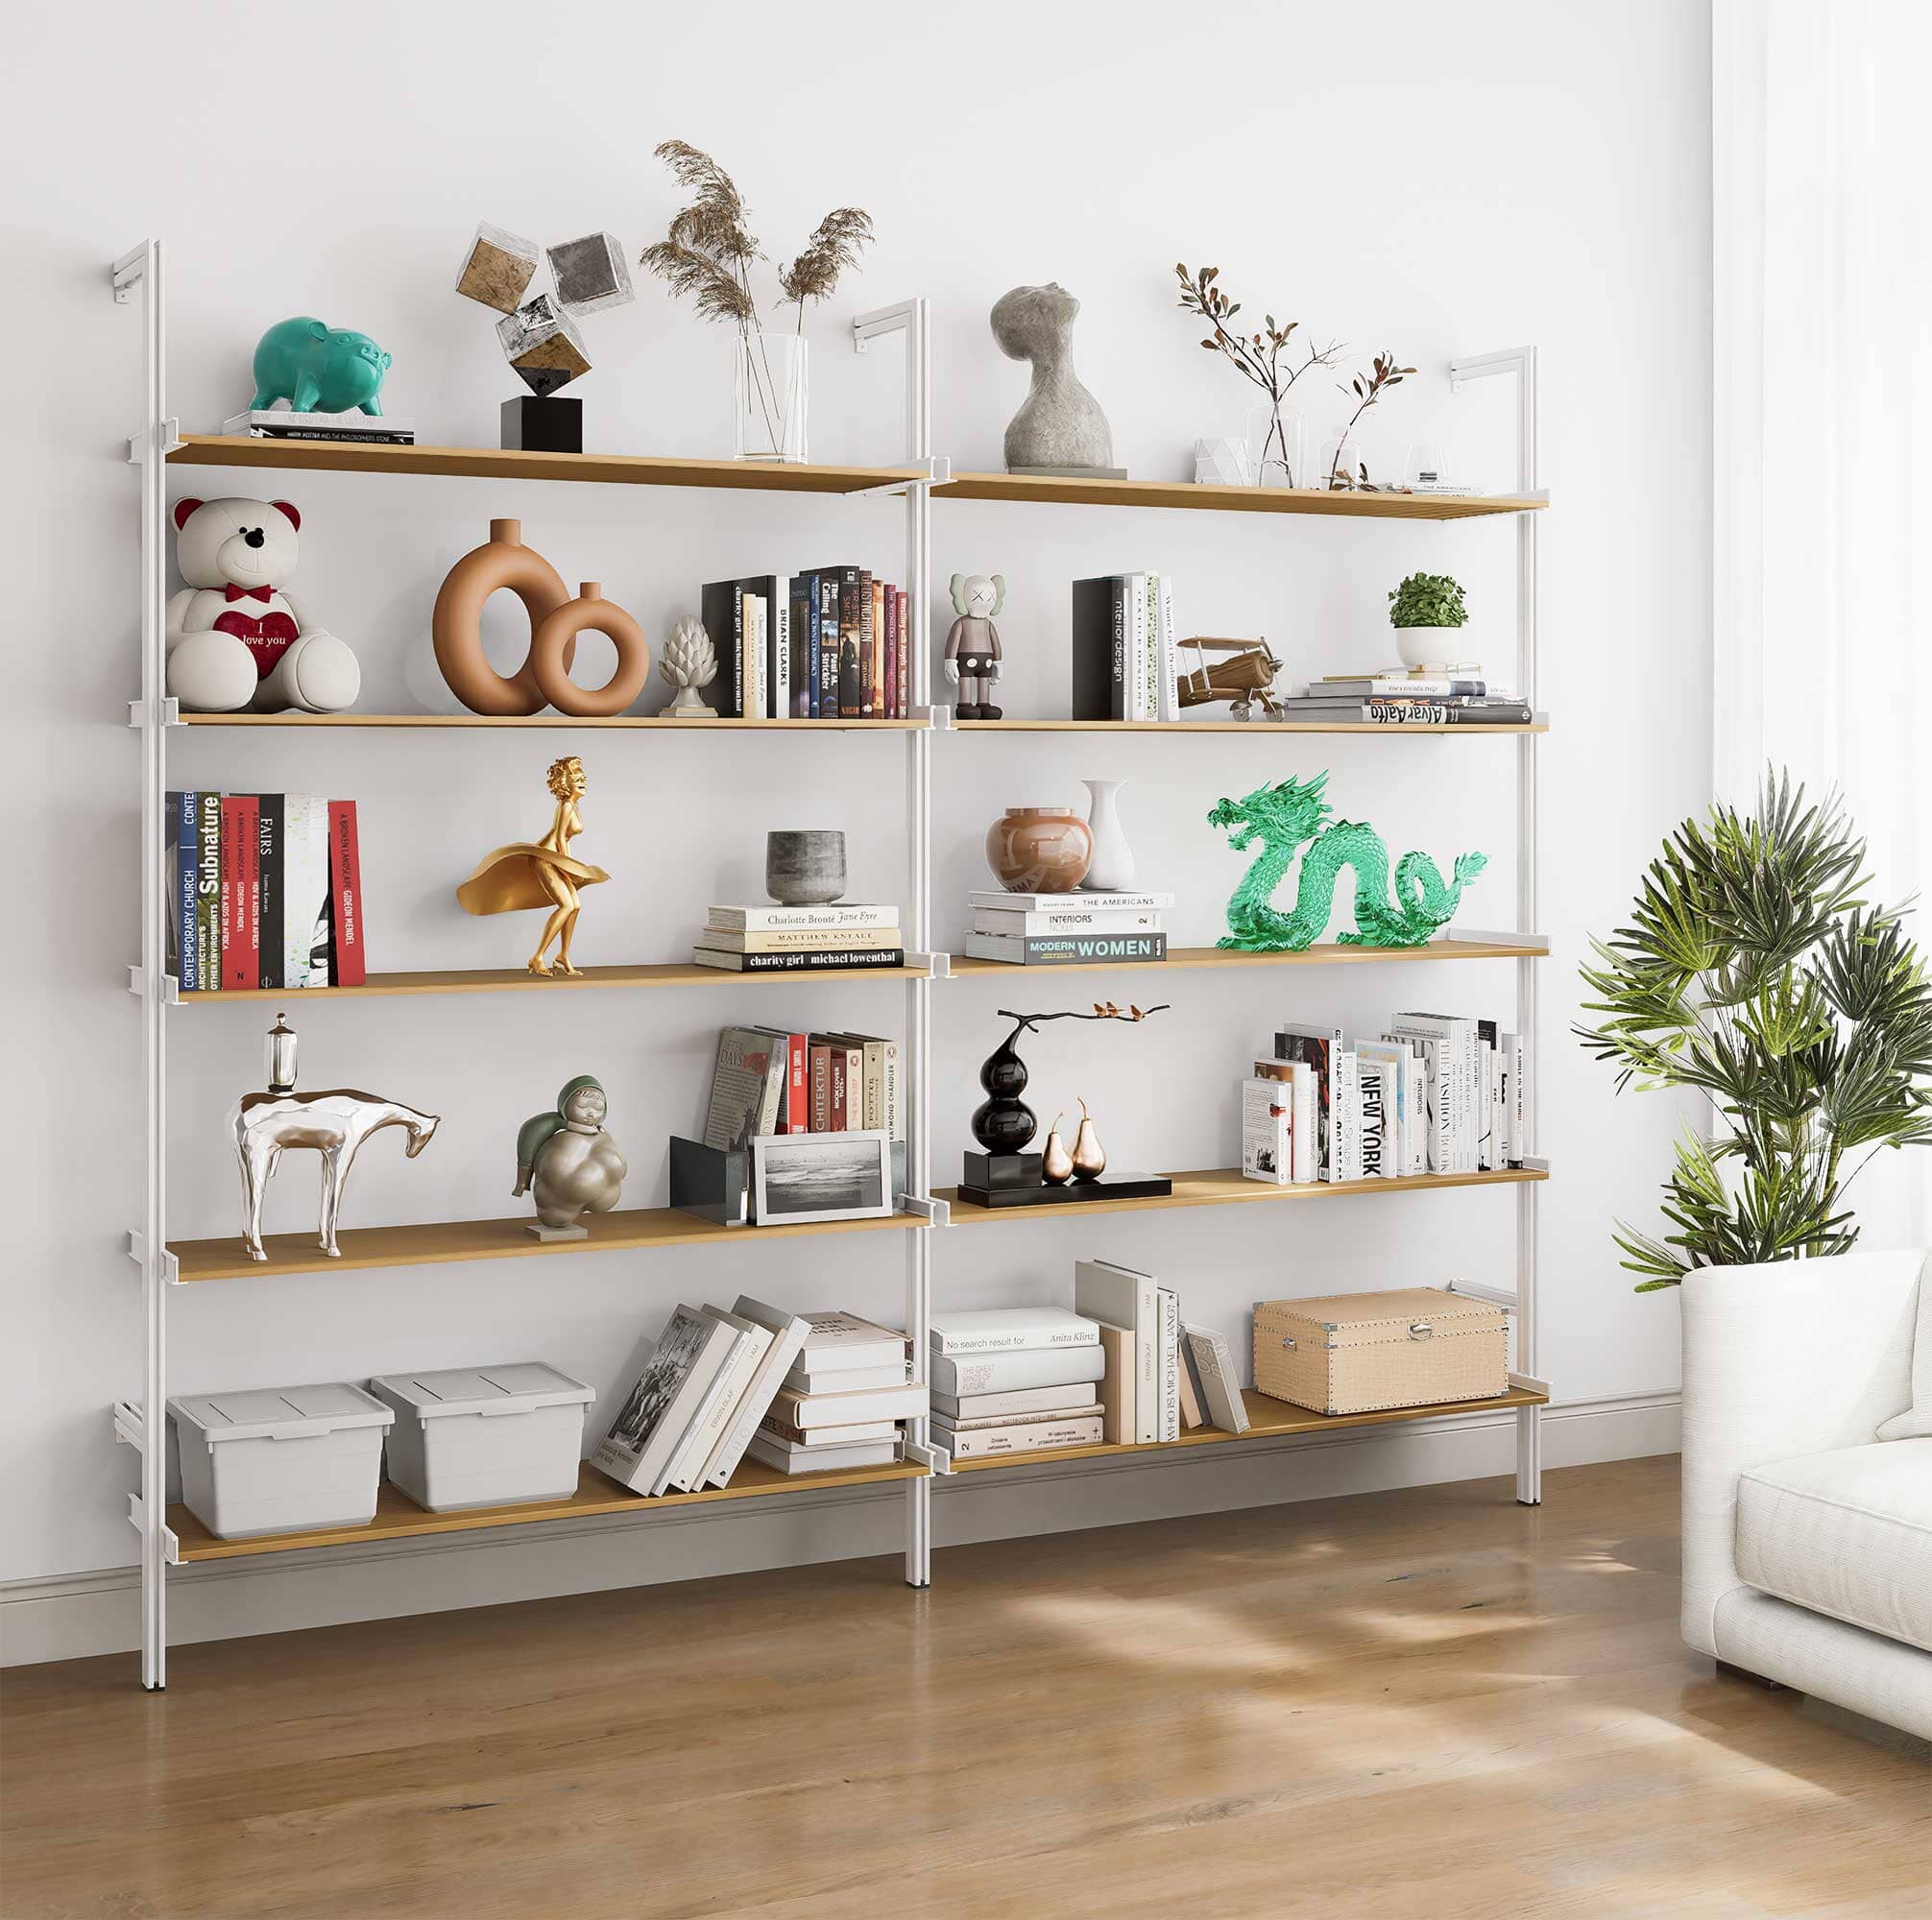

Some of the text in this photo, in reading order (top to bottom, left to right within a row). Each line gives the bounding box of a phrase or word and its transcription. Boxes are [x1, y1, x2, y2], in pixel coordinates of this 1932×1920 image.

[821, 583, 831, 614] Calling
[831, 583, 839, 599] The
[258, 621, 263, 634] I
[898, 598, 907, 629] Wrestling
[243, 635, 286, 648] love you
[821, 653, 831, 690] Strickler
[1371, 707, 1407, 724] Aalto
[1408, 707, 1442, 724] Alvar
[183, 791, 194, 825] CONTE
[199, 797, 219, 895] Subnature
[259, 818, 273, 855] FAIRS
[340, 820, 350, 848] BROKEN
[341, 849, 351, 889] LANDSCAPE
[343, 890, 352, 917] GIDEON
[184, 870, 194, 988] CONTEMPORARY CHURCH
[345, 918, 354, 946] MENDEL
[767, 914, 806, 925] Charlotte
[837, 912, 857, 923] Jane
[1049, 915, 1093, 924] INTERIORS
[198, 925, 206, 991] ARCHITECTURE'S
[750, 951, 896, 968] charity girl michael lowenthal
[1029, 941, 1075, 951] MODERN
[1078, 939, 1150, 956] WOMEN
[720, 1049, 742, 1067] DAYS
[1440, 1073, 1450, 1131] FASHION
[1361, 1075, 1381, 1176] NEW YORK
[1440, 1135, 1450, 1172] BOOK
[947, 1336, 1026, 1351] No search result for
[1050, 1332, 1072, 1343] Anita
[1167, 1305, 1176, 1442] WHO IS MICHAEL JANG?
